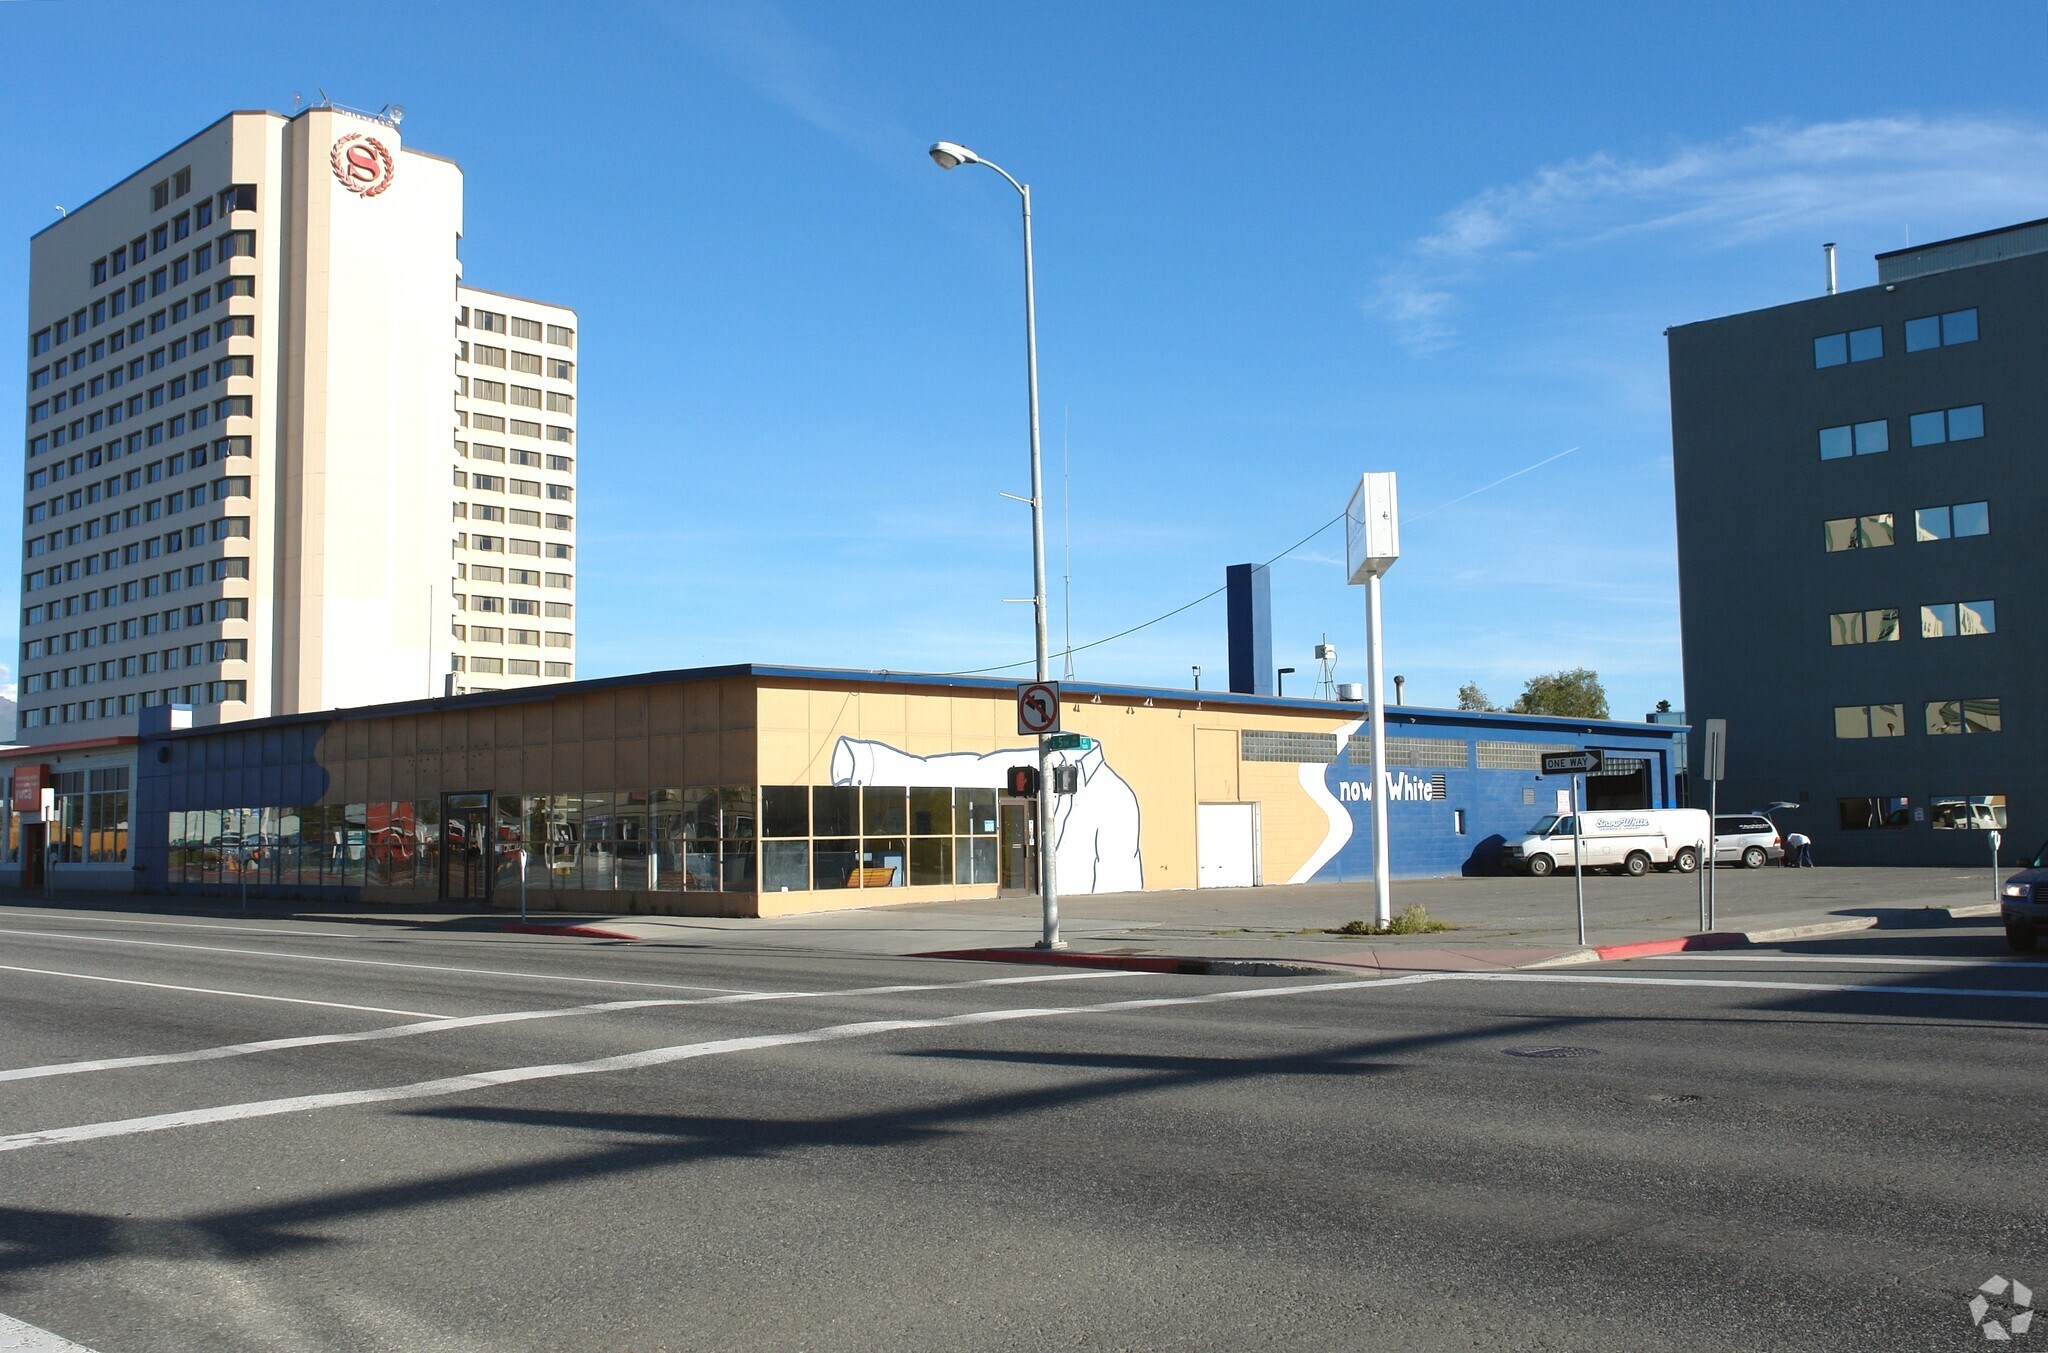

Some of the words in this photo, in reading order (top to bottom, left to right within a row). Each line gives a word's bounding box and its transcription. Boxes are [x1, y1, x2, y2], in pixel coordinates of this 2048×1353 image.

[347, 144, 381, 182] S
[1548, 759, 1566, 768] ONE
[1569, 757, 1588, 767] WAY
[1385, 771, 1433, 802] White
[1596, 817, 1621, 828] Snow
[1619, 817, 1649, 827] White
